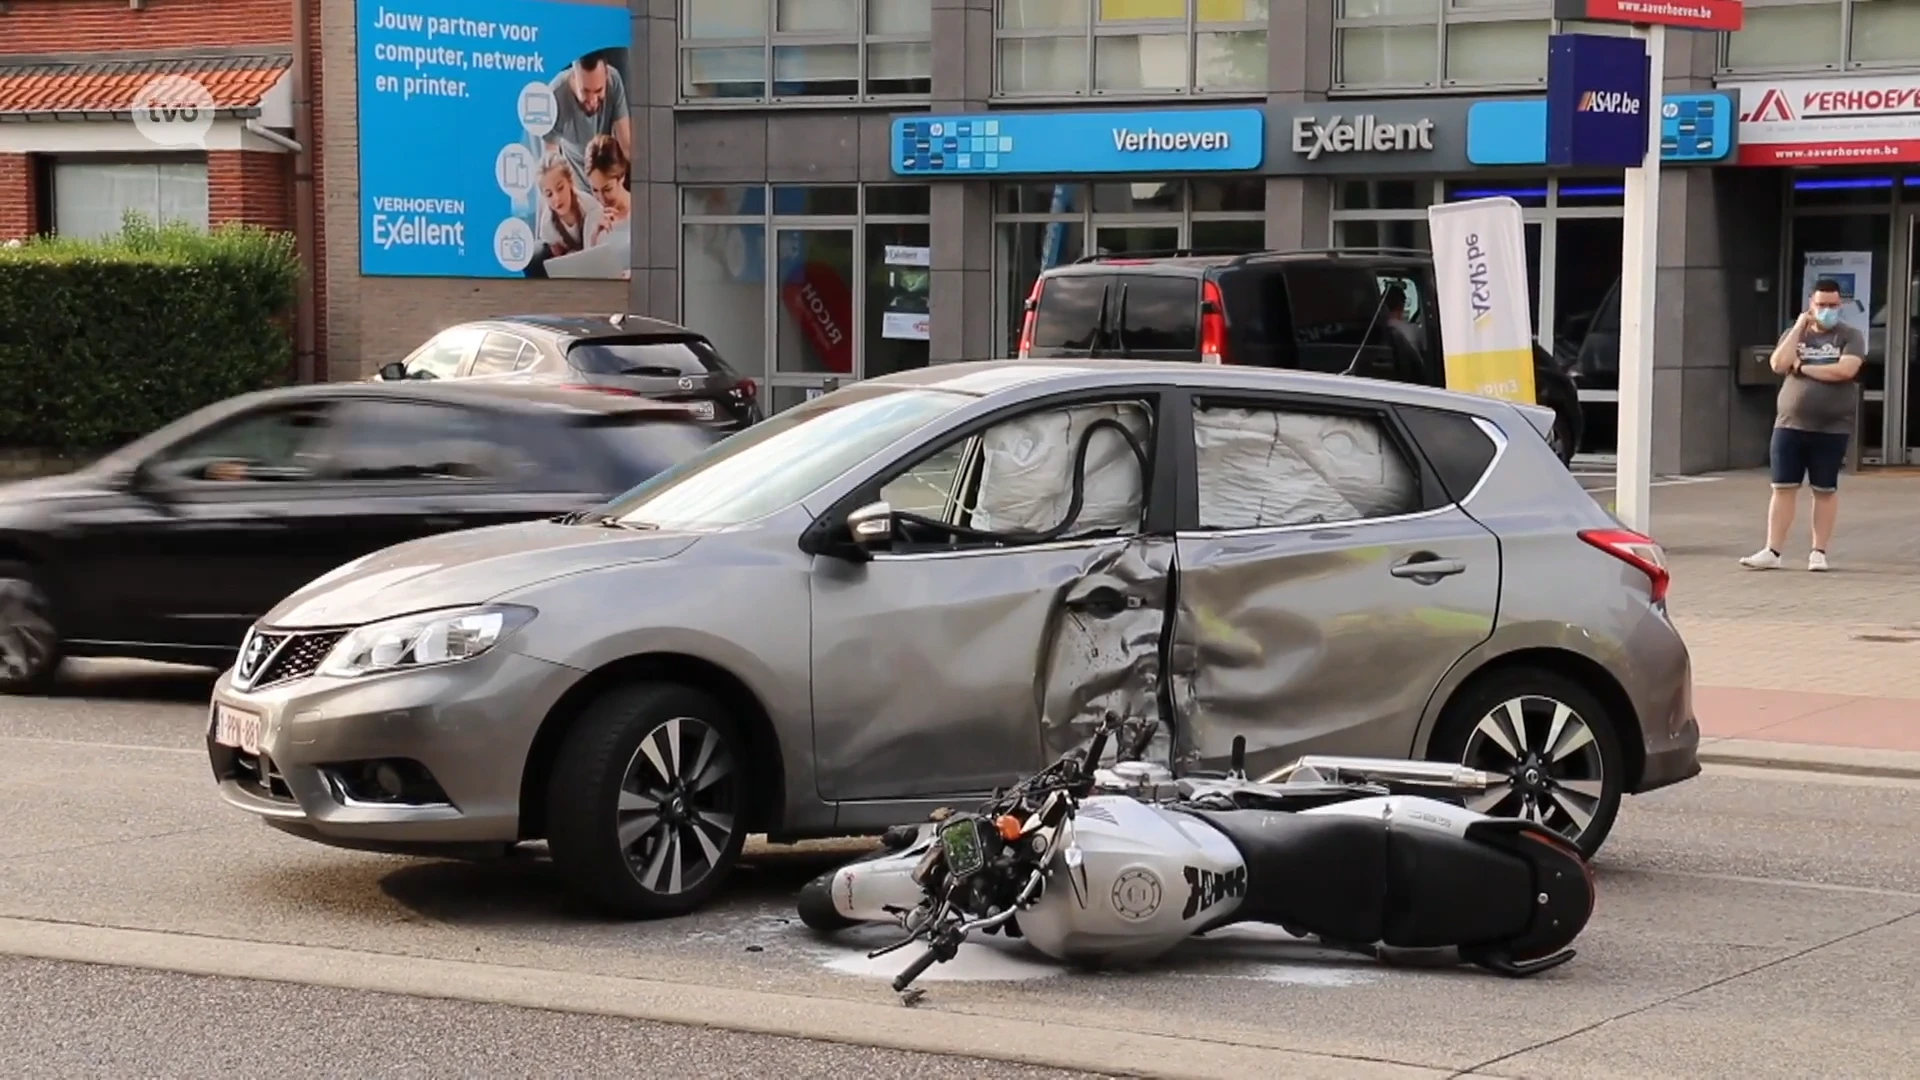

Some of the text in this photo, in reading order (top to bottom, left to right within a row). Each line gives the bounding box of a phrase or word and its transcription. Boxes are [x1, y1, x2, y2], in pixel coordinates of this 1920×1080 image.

[1617, 1, 1712, 19] www.aaverhoeven.be
[374, 6, 539, 42] Jouw partner voor
[374, 43, 545, 73] computer, netwerk
[375, 74, 470, 100] en printer.
[1587, 90, 1640, 115] ASAP.be
[1112, 128, 1229, 151] Verhoeven
[1775, 146, 1899, 160] www.aaverhoeven.be
[373, 196, 465, 214] VERHOEVEN
